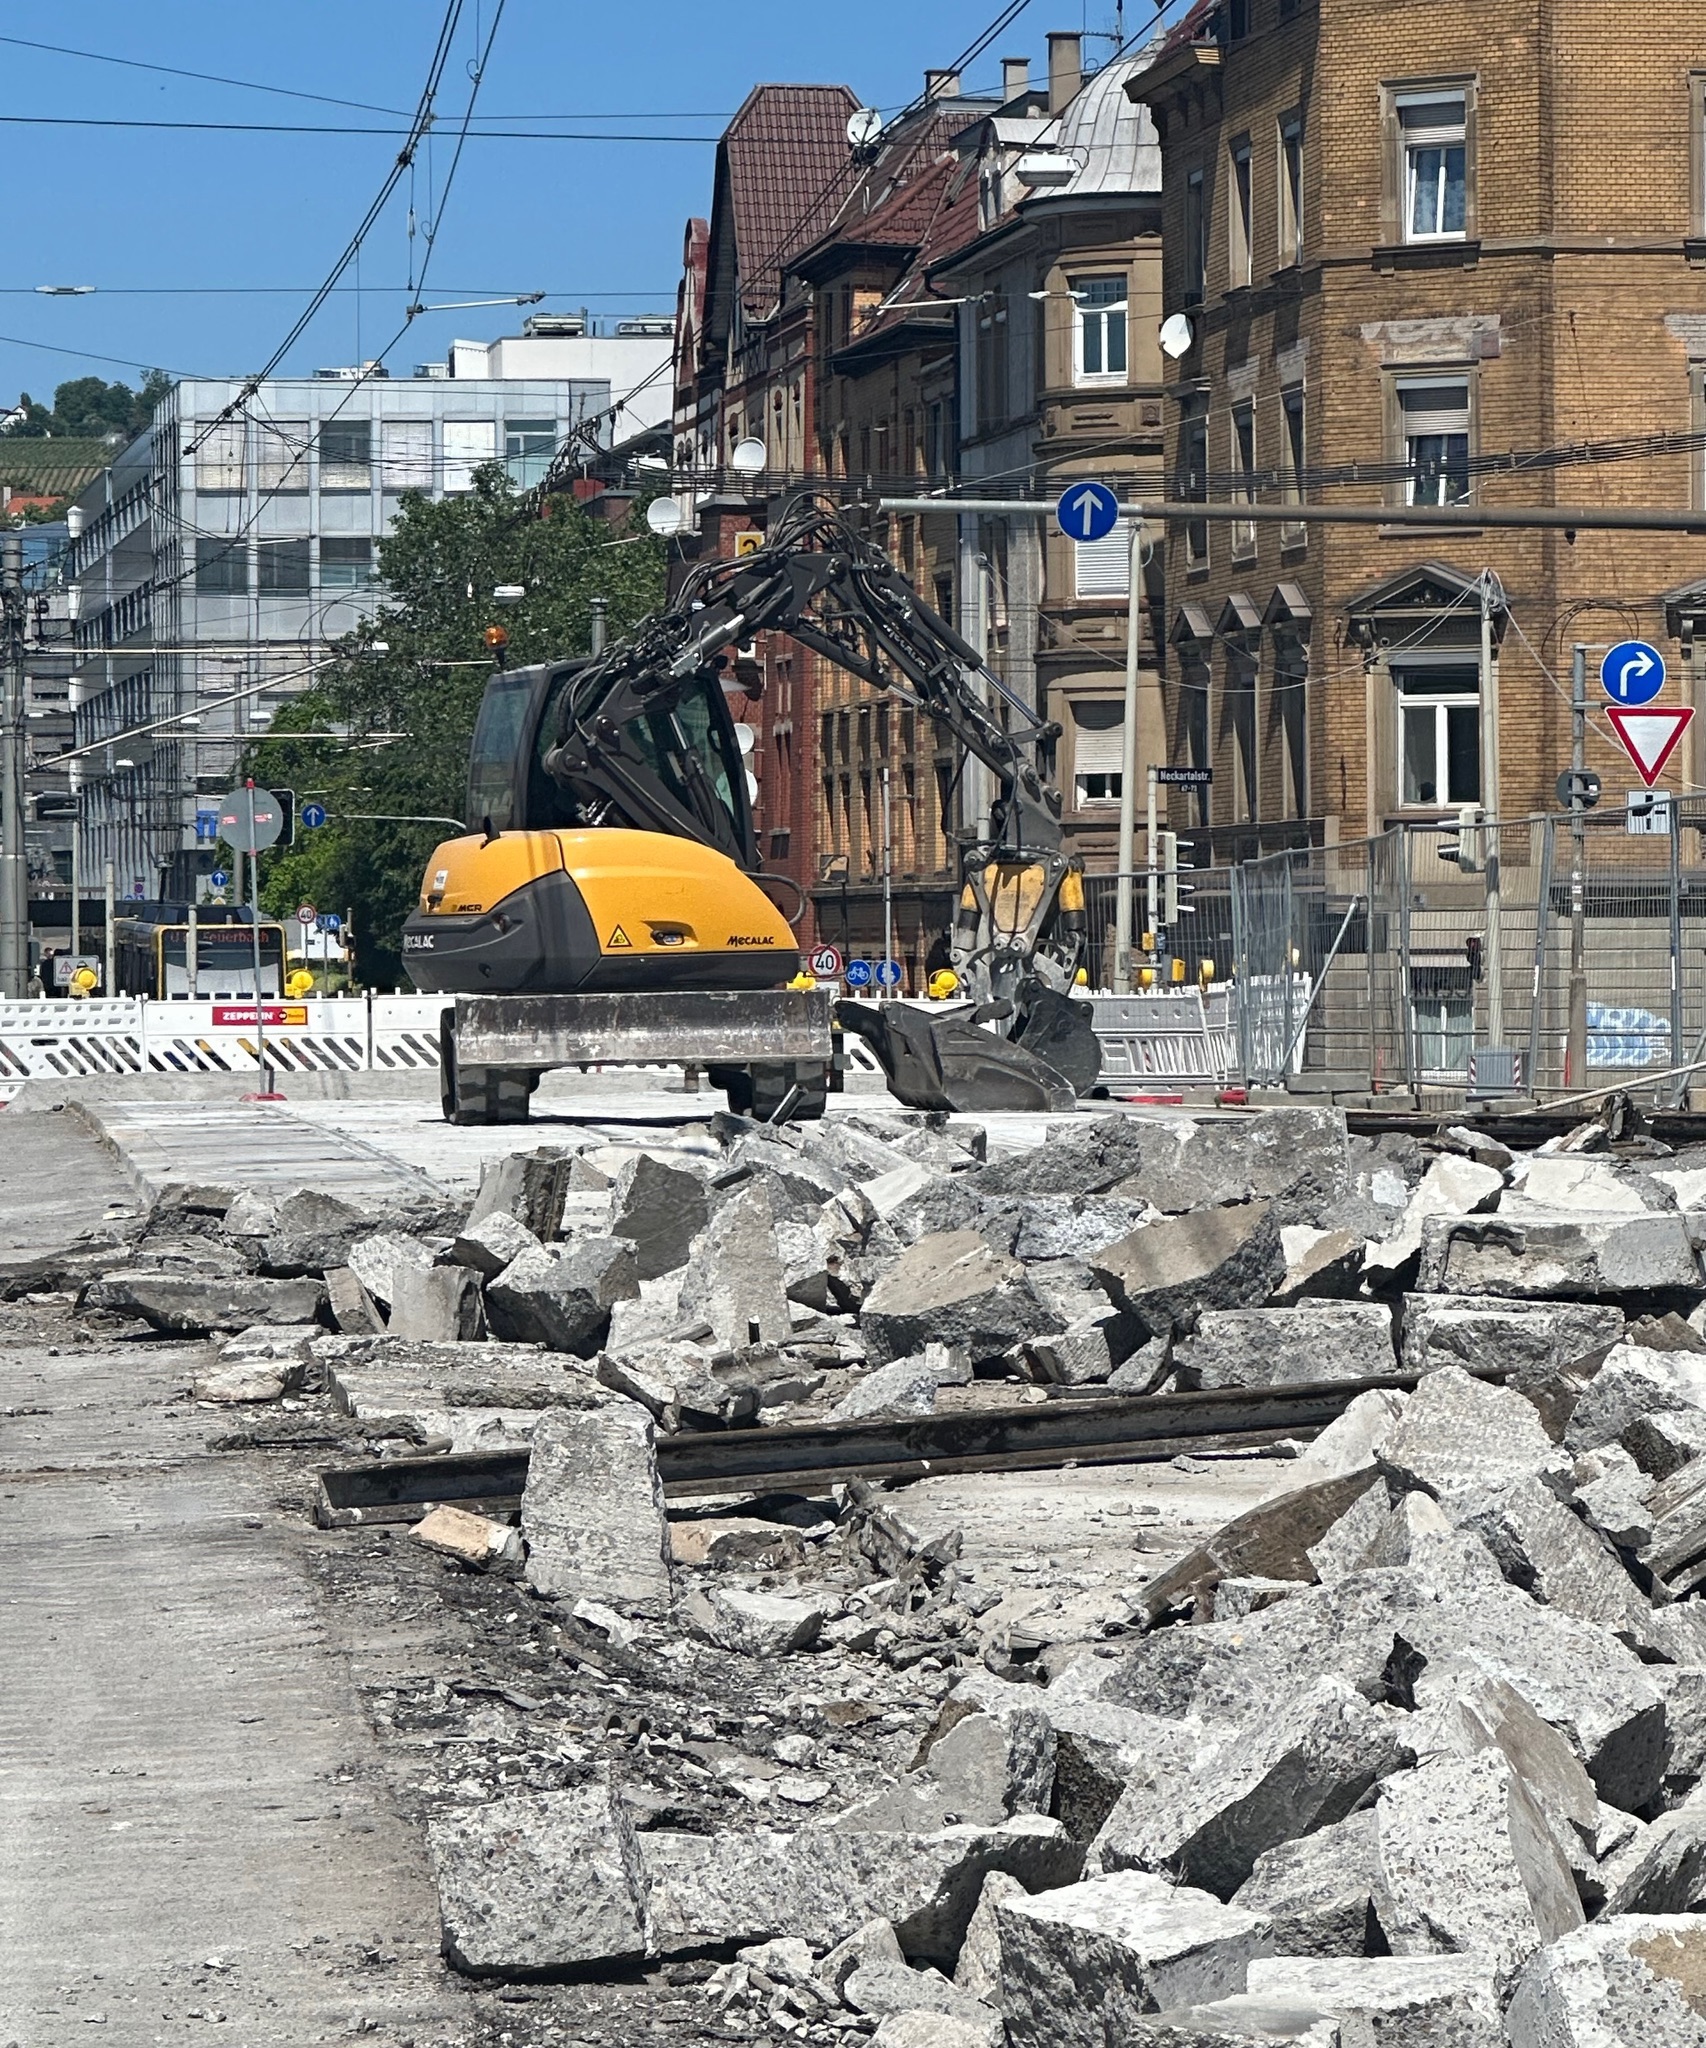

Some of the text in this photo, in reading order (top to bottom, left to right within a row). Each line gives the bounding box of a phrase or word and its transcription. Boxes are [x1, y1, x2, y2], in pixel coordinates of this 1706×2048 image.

[1160, 770, 1211, 781] Neckartalstr.
[300, 910, 312, 919] 40
[203, 931, 269, 943] Feuerbah
[815, 954, 835, 971] 40
[222, 1011, 274, 1021] ZEPPEIN
